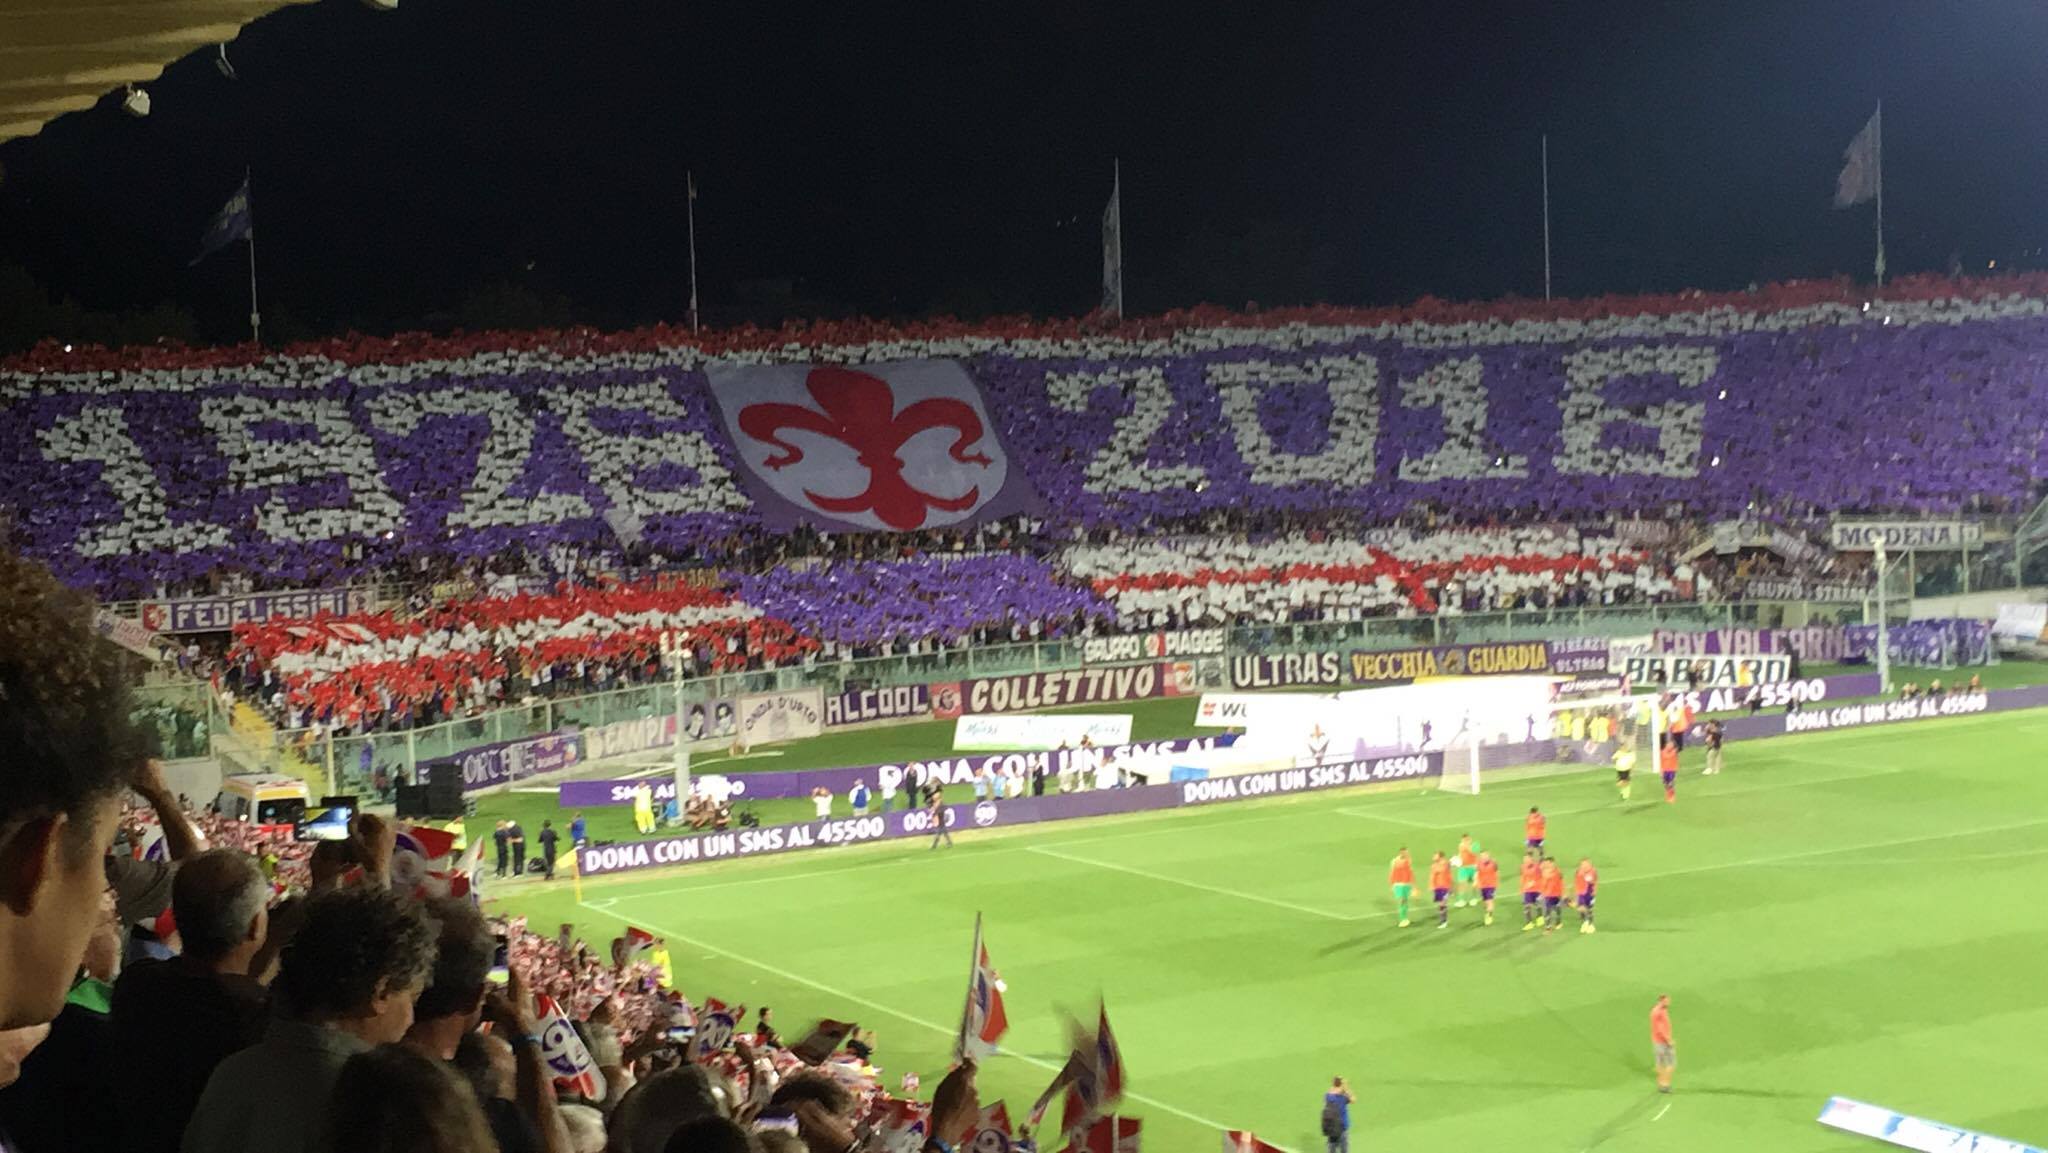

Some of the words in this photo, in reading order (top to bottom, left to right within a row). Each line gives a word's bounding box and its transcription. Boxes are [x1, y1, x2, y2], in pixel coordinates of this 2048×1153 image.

[1046, 346, 1718, 492] 2016
[1839, 526, 1952, 546] MODENA
[1084, 635, 1140, 662] GRUPPO
[1165, 629, 1224, 656] PIAGGE
[1352, 649, 1438, 680] VECCHIA
[1468, 643, 1547, 674] GUARDIA
[1234, 651, 1339, 687] ULTRAS
[827, 686, 929, 724] ALCOOL
[972, 664, 1156, 713] COLLETTIVO
[1706, 688, 1739, 712] AL
[1785, 711, 1828, 732] DONA
[1830, 706, 1861, 727] CON
[1864, 702, 1886, 723] UN
[1887, 698, 1920, 721] SMS
[1919, 696, 1940, 717] AL
[1183, 780, 1237, 803] DONA
[1239, 774, 1277, 797] CON
[1279, 770, 1308, 792] UN
[1309, 764, 1346, 788] SMS
[1348, 762, 1371, 783] AL
[1371, 755, 1429, 780] 45500
[584, 843, 650, 873] DONA
[653, 837, 699, 864] CON
[702, 833, 737, 857] UN
[739, 827, 784, 853] SMS
[787, 824, 815, 848] AL
[817, 815, 886, 843] 45500
